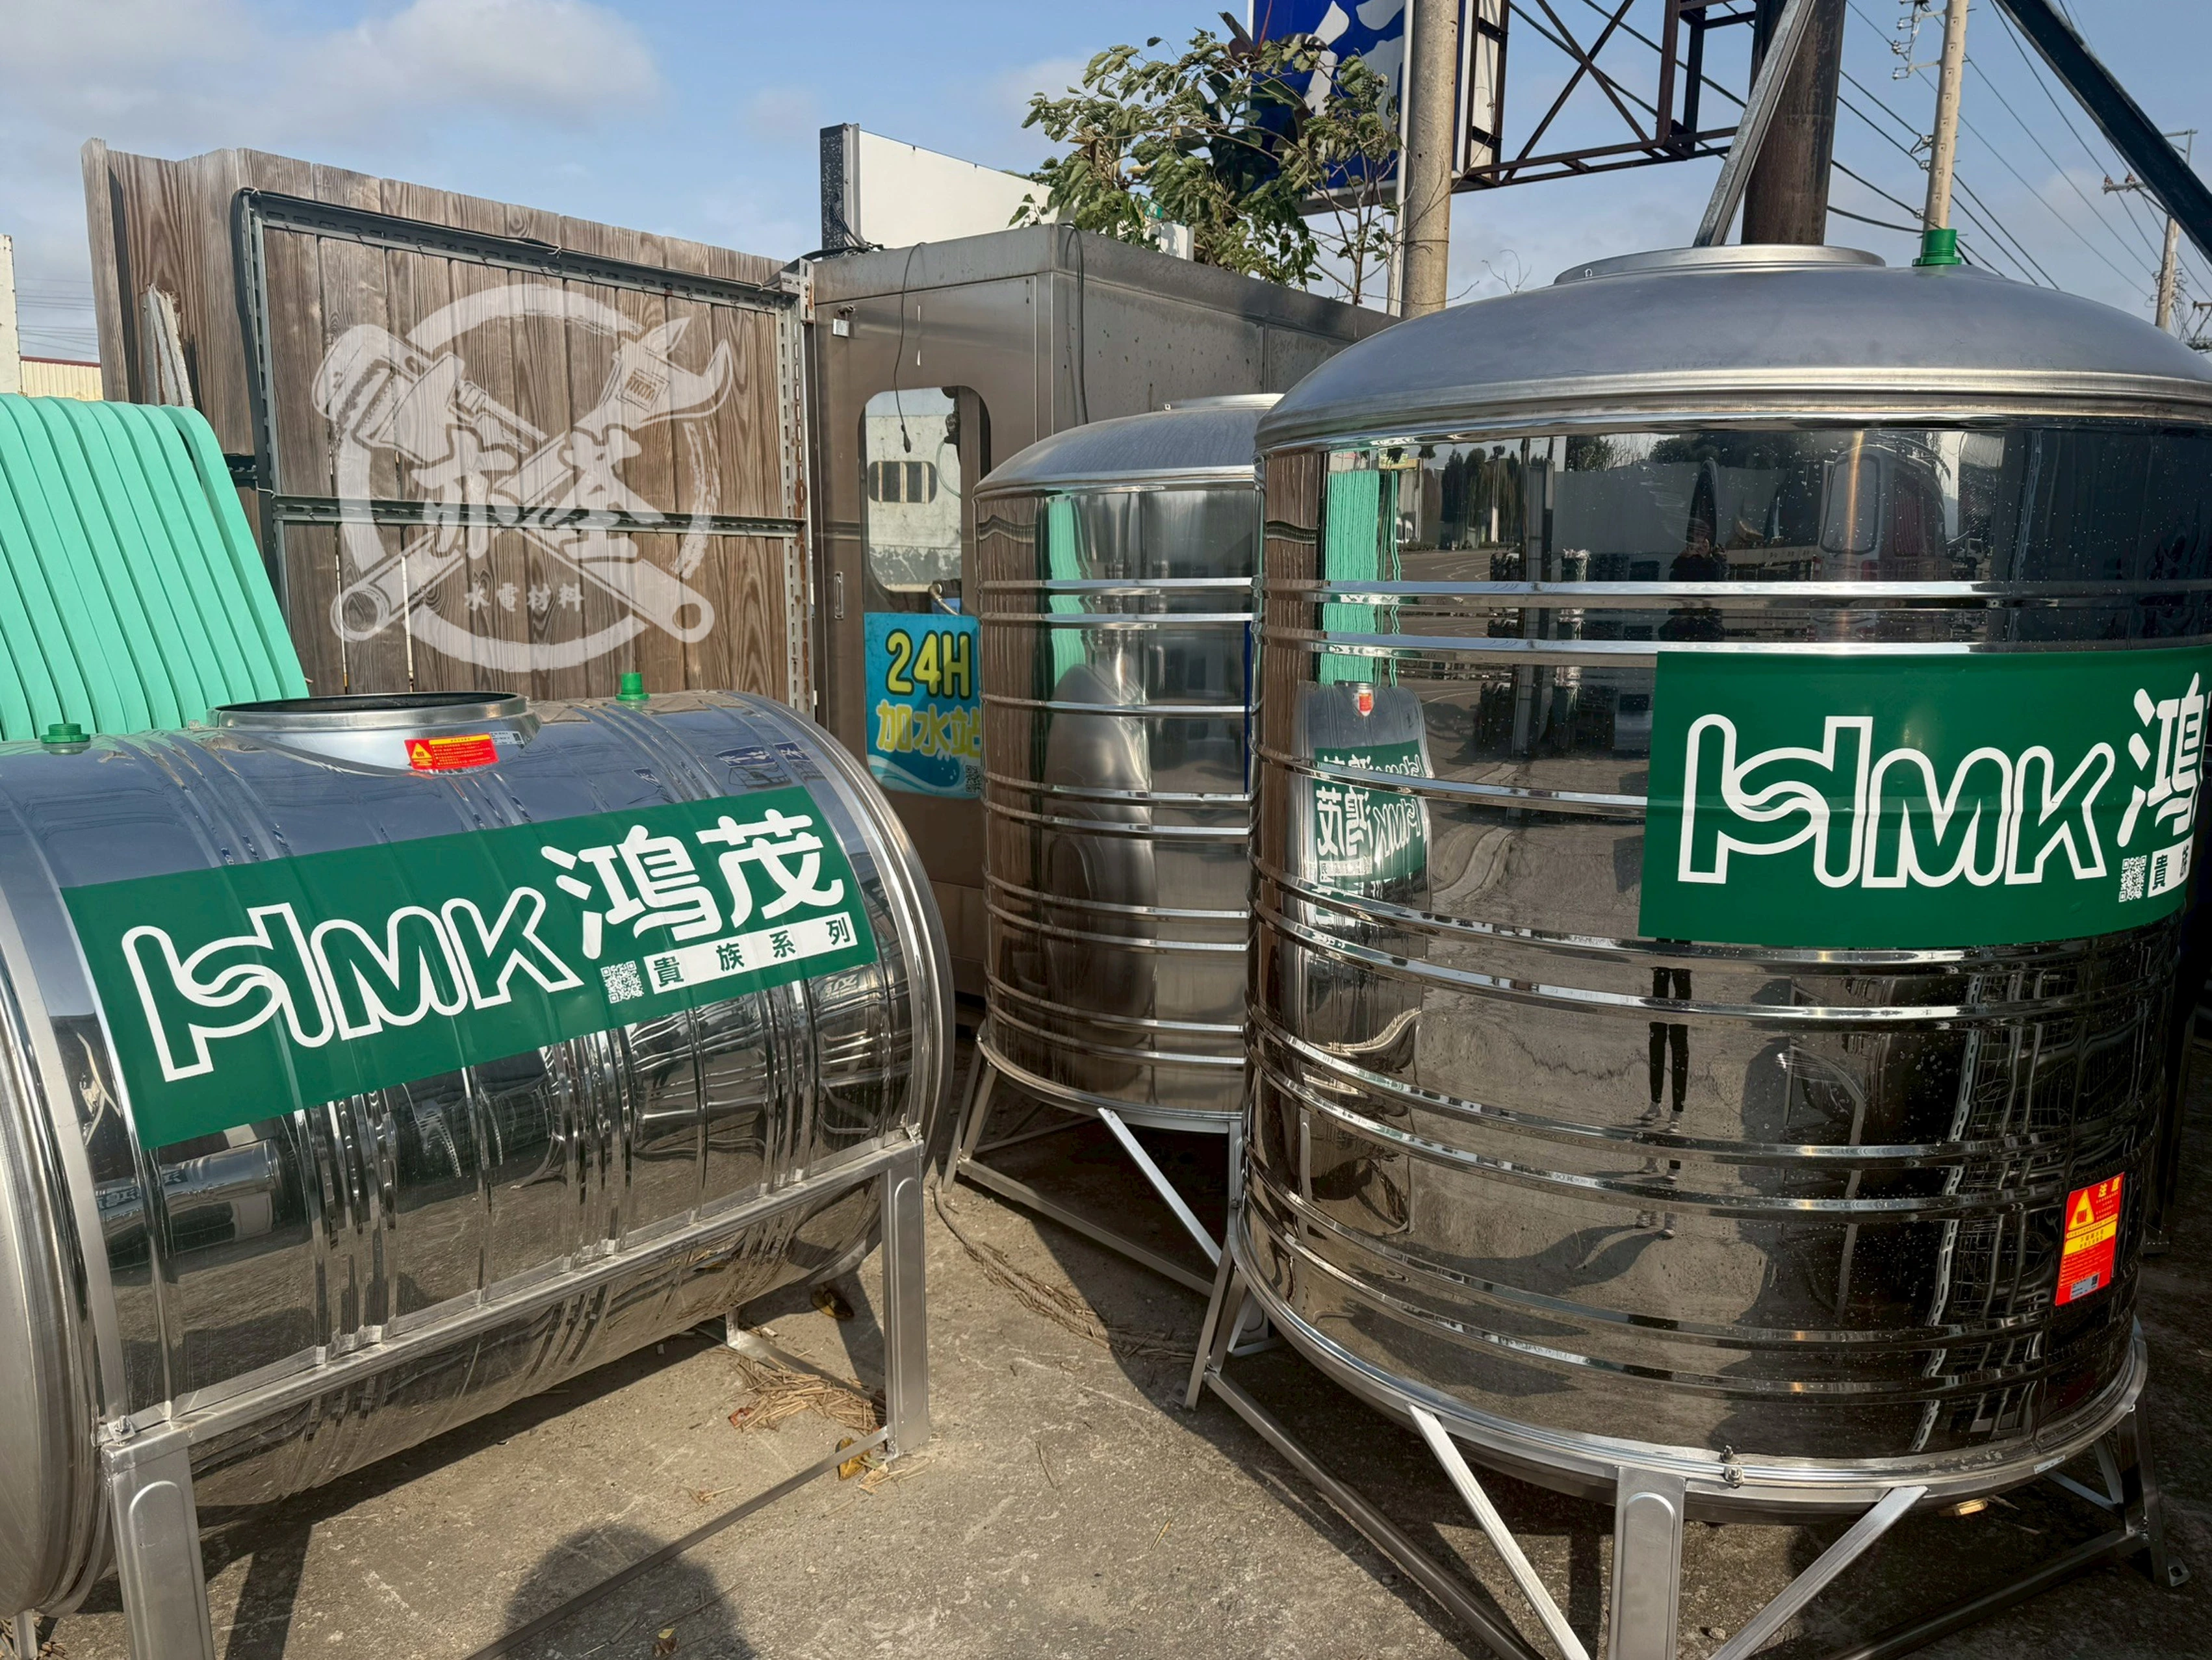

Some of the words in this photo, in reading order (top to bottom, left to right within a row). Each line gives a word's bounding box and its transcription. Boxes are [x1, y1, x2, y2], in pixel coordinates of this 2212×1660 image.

[885, 628, 971, 700] 24H
[876, 698, 981, 758] 加水站
[1678, 714, 2116, 888] HMK
[2117, 671, 2212, 848] 鴻
[122, 886, 584, 1082] HMK
[541, 808, 845, 960] 鴻茂
[653, 916, 853, 989] 貴族系列
